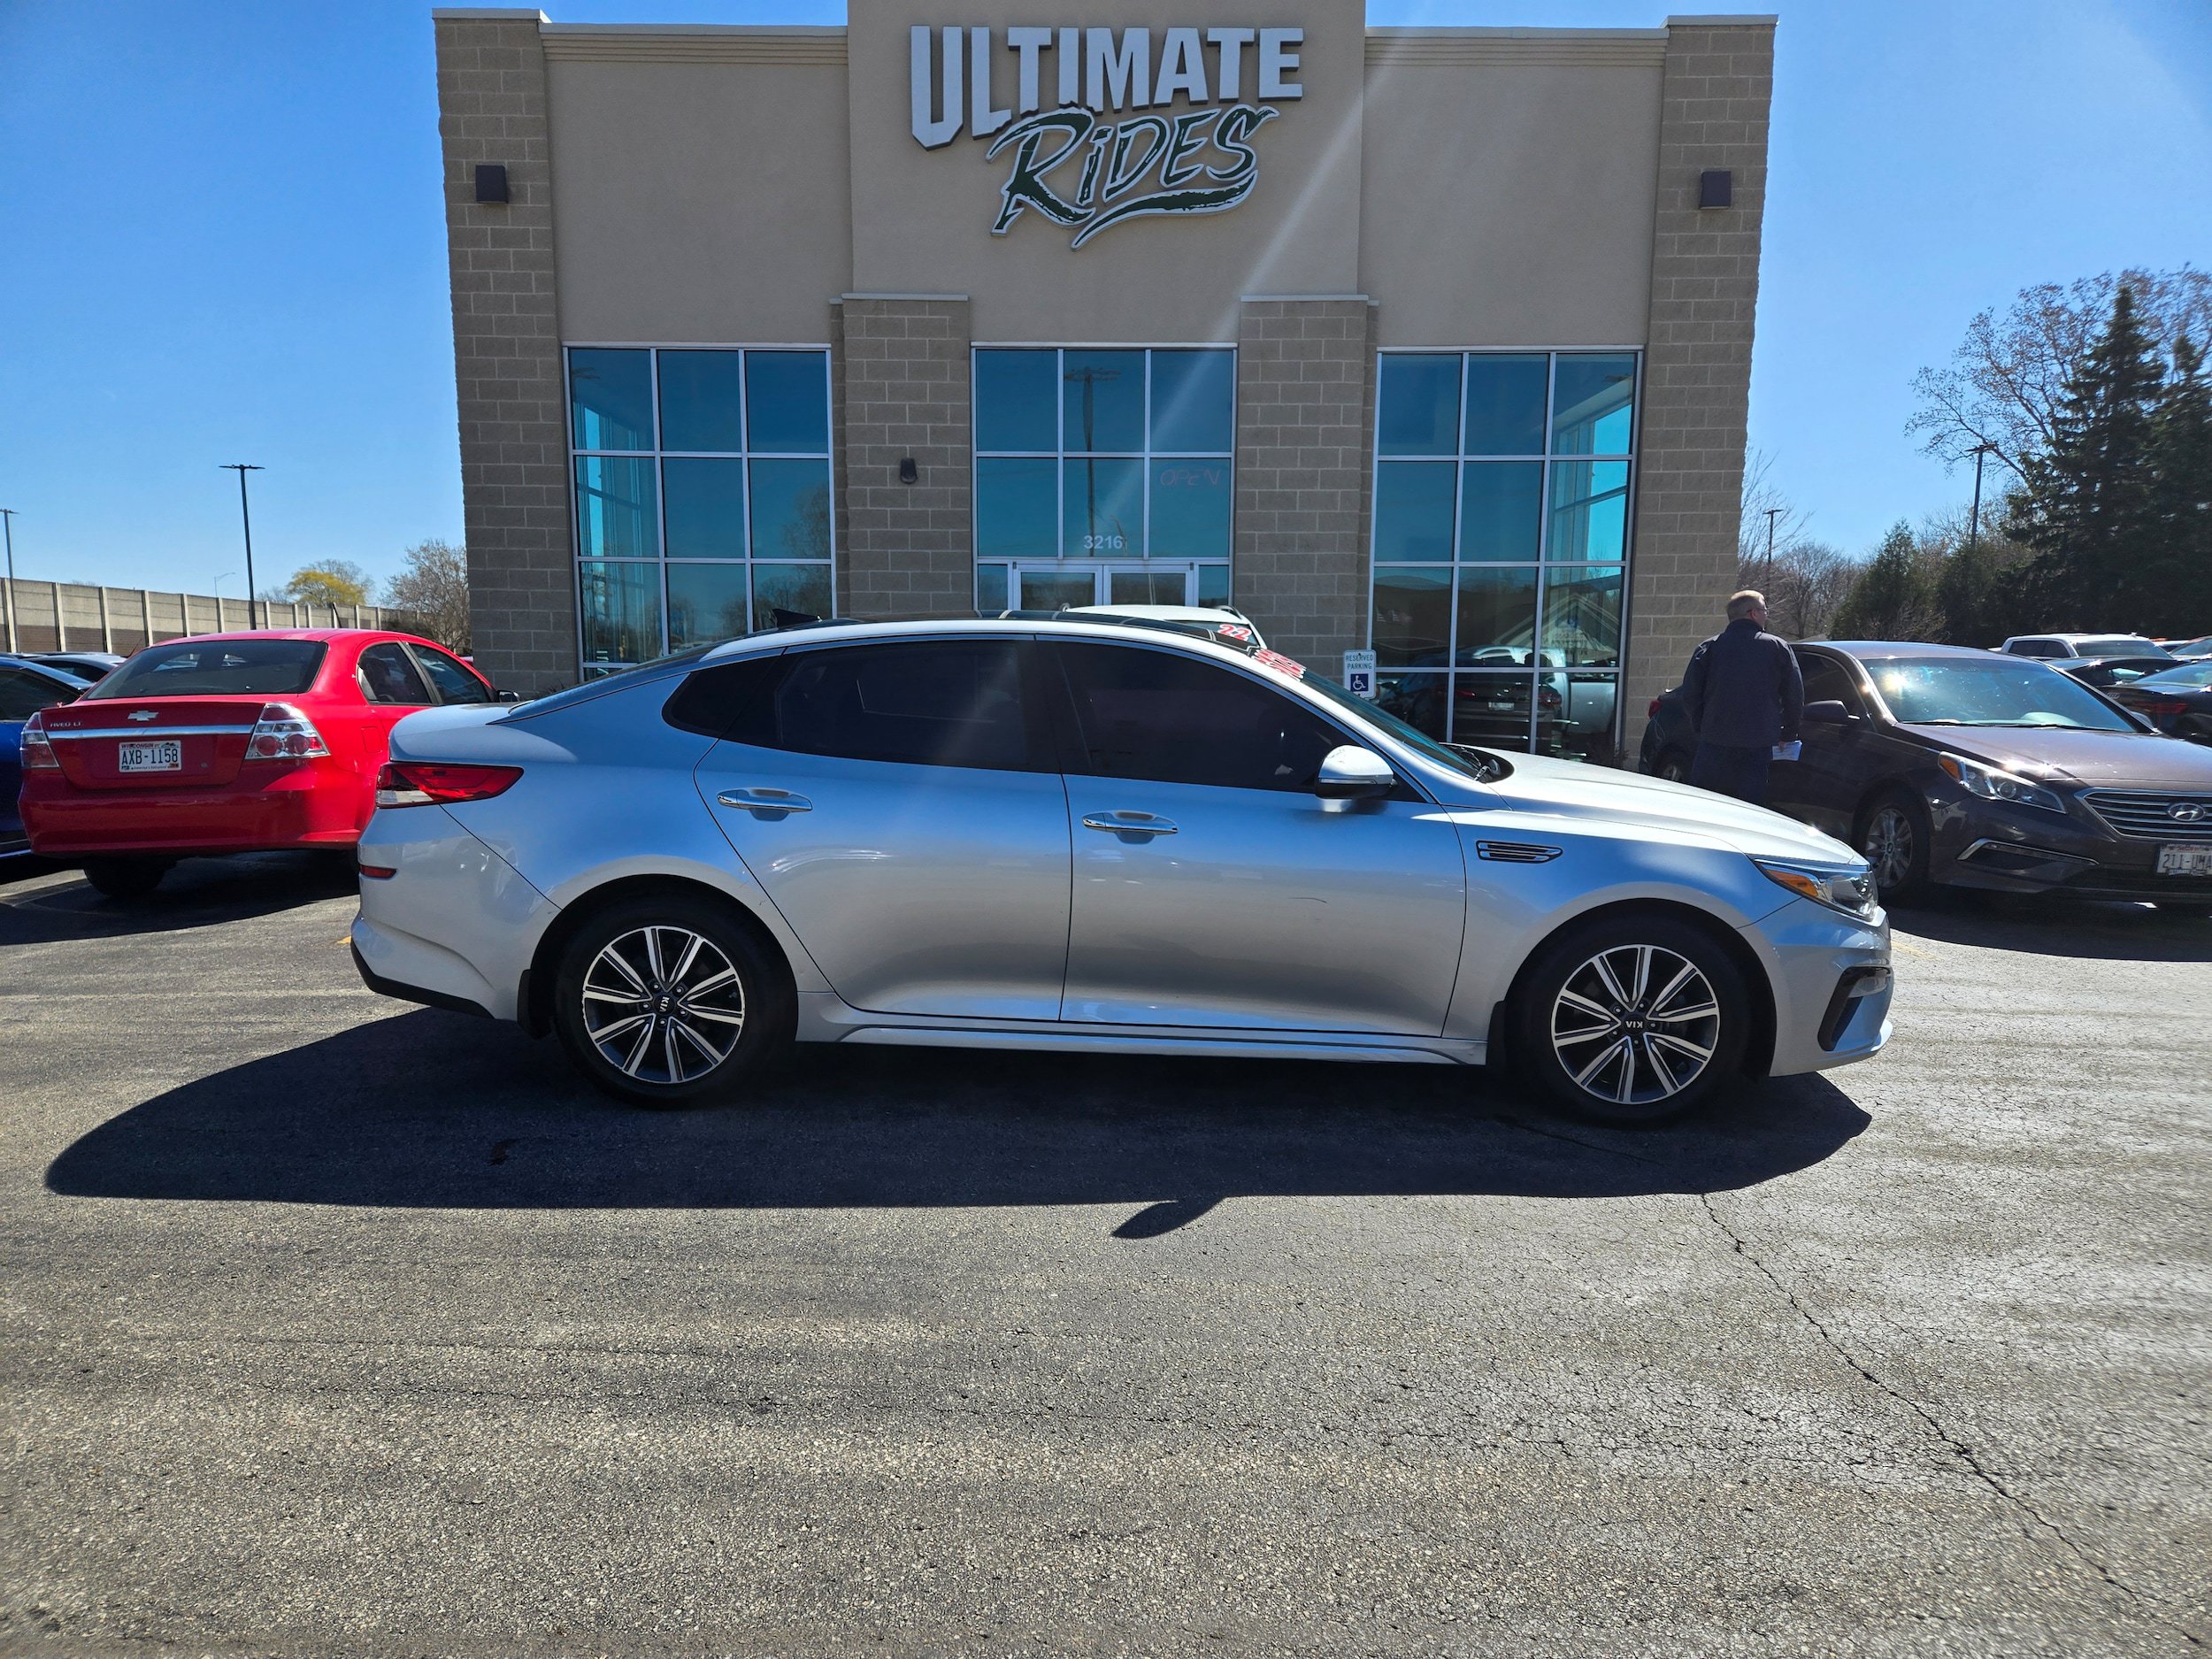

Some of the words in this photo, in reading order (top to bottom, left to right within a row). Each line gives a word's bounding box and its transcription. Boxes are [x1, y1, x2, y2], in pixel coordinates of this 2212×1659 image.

[910, 25, 1304, 150] ULTIMATE
[1084, 534, 1124, 549] 3216
[1217, 623, 1253, 642] 22
[121, 749, 179, 765] AXB-1158
